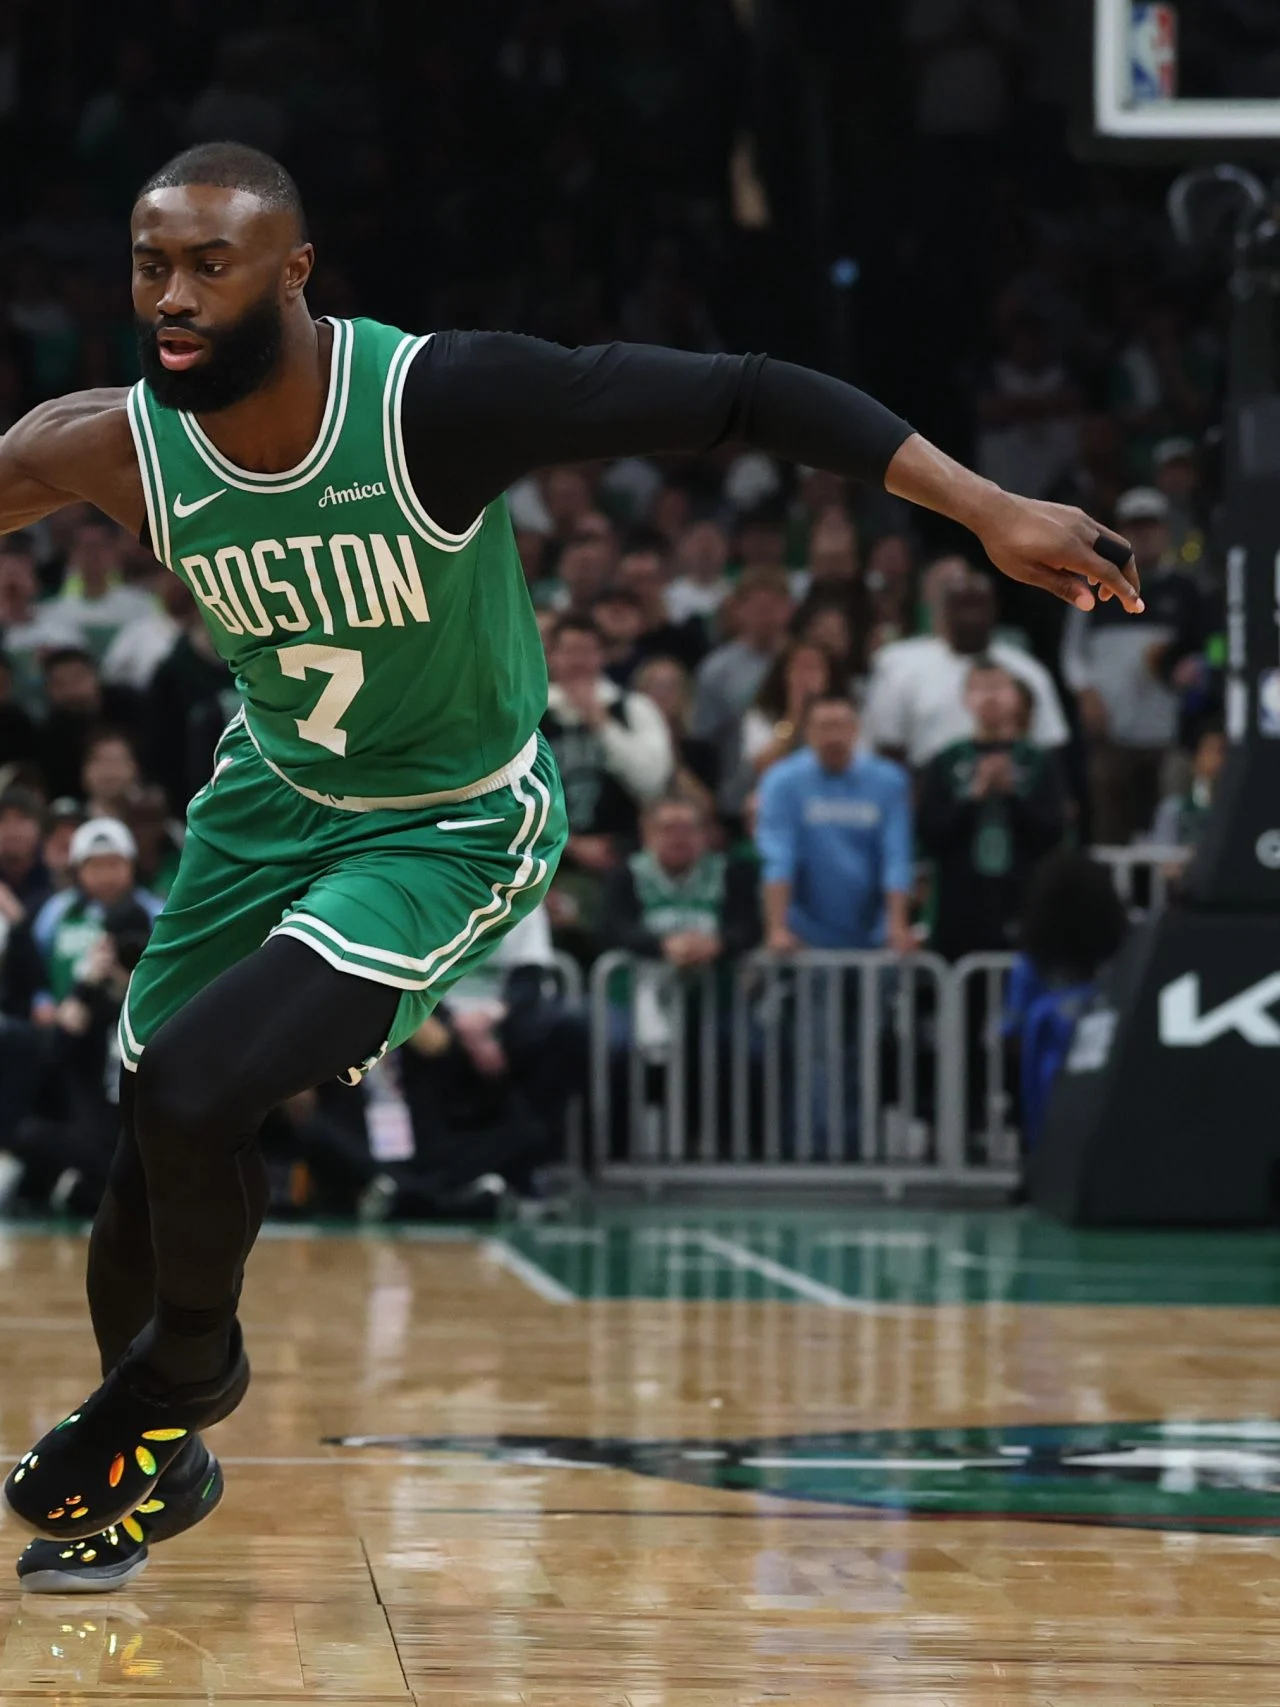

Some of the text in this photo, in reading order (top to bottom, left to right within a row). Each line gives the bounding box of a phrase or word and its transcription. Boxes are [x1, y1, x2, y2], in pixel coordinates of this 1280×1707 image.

[318, 481, 386, 508] Amica
[180, 533, 431, 637] BOSTON
[276, 643, 365, 758] 7
